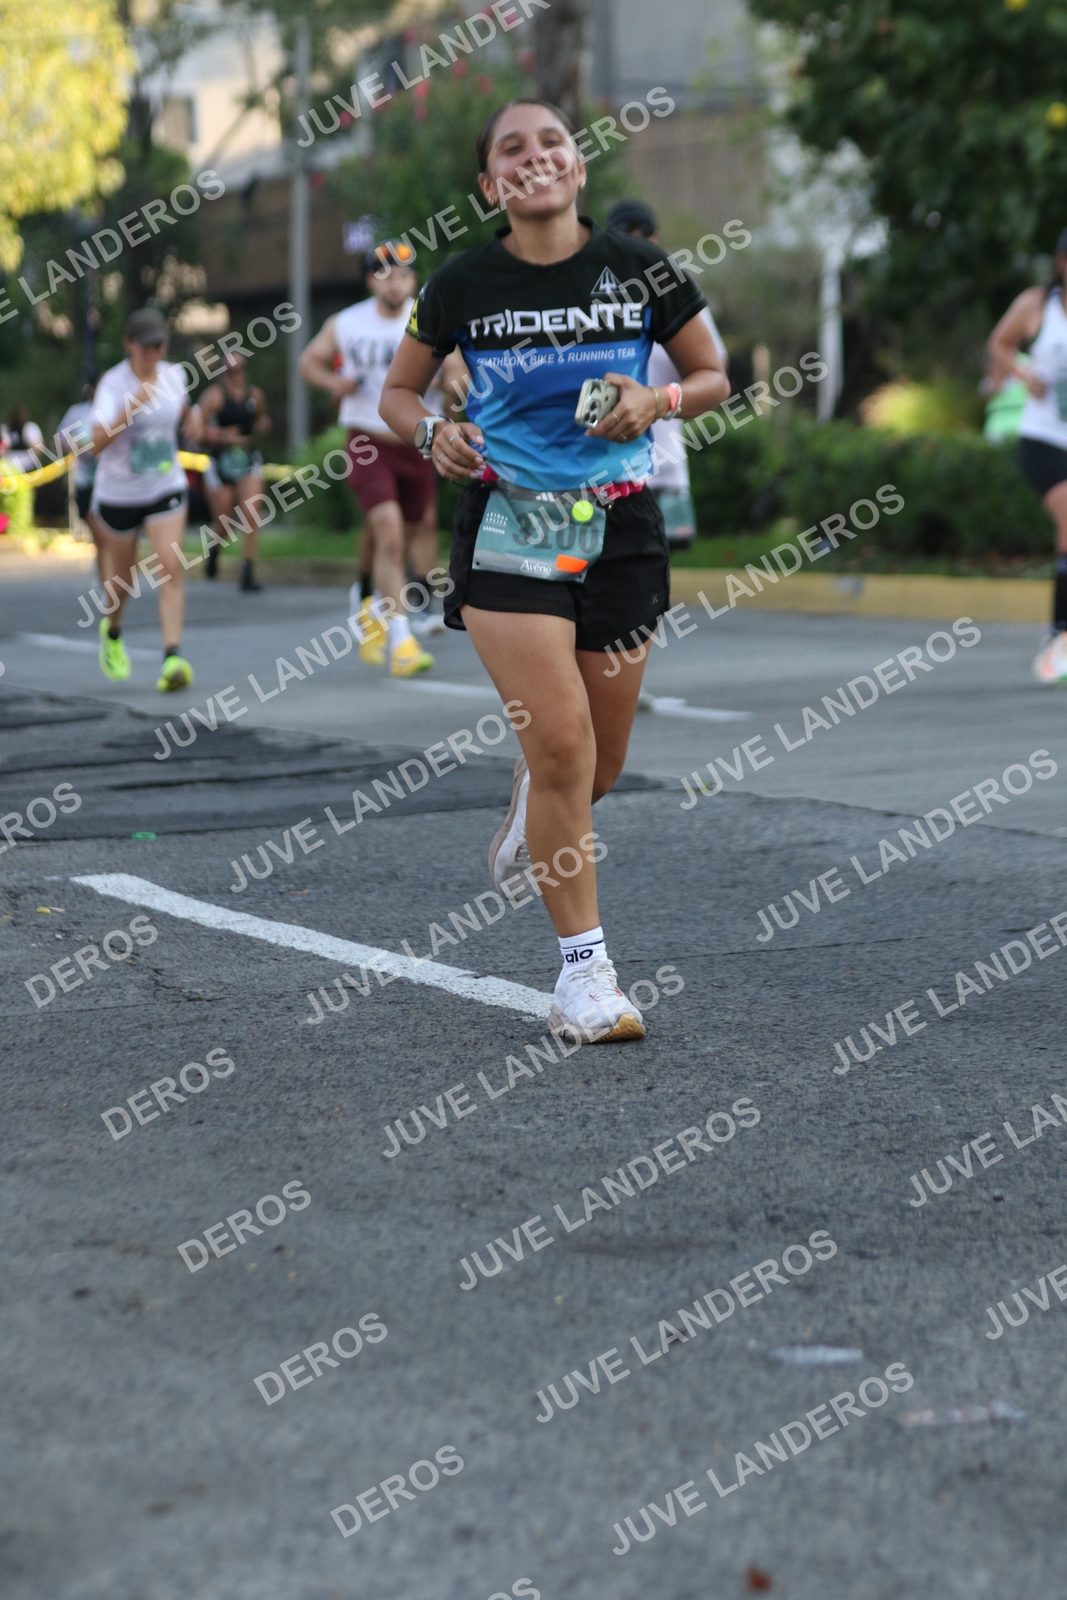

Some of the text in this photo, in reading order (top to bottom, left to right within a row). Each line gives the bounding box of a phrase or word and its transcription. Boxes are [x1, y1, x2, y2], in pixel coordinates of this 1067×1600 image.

[467, 303, 643, 339] TRIDENTE
[530, 353, 555, 365] BIKE
[567, 349, 615, 362] RUNNING
[565, 949, 593, 963] alo
